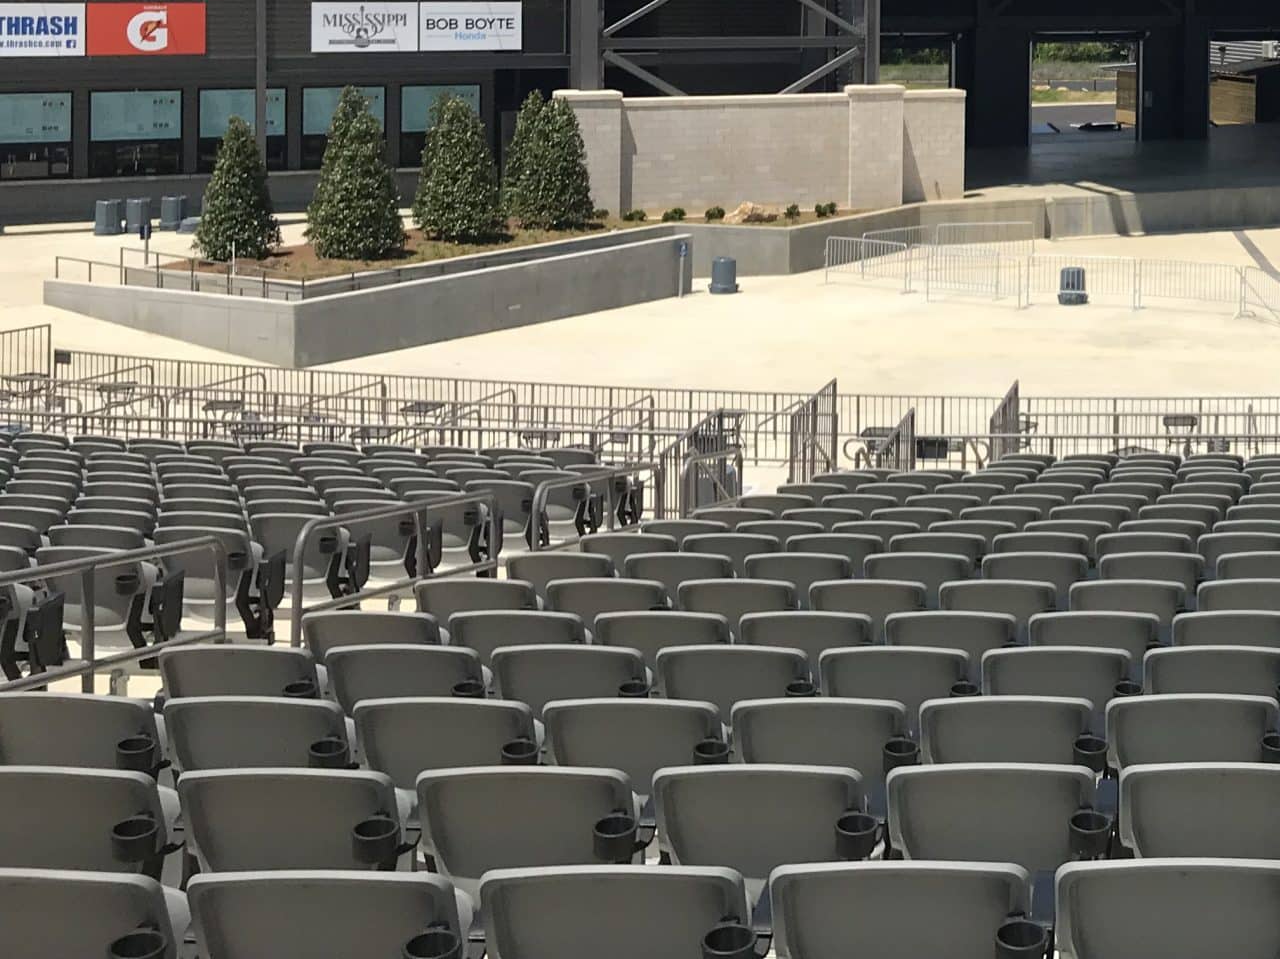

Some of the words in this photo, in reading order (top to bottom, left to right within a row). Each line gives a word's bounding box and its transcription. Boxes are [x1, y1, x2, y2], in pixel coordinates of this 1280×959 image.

[0, 16, 77, 36] THRASH
[322, 13, 407, 34] MISSISSIPPI
[426, 18, 458, 30] BOB
[465, 18, 515, 30] BOYTE
[454, 30, 486, 40] Honda
